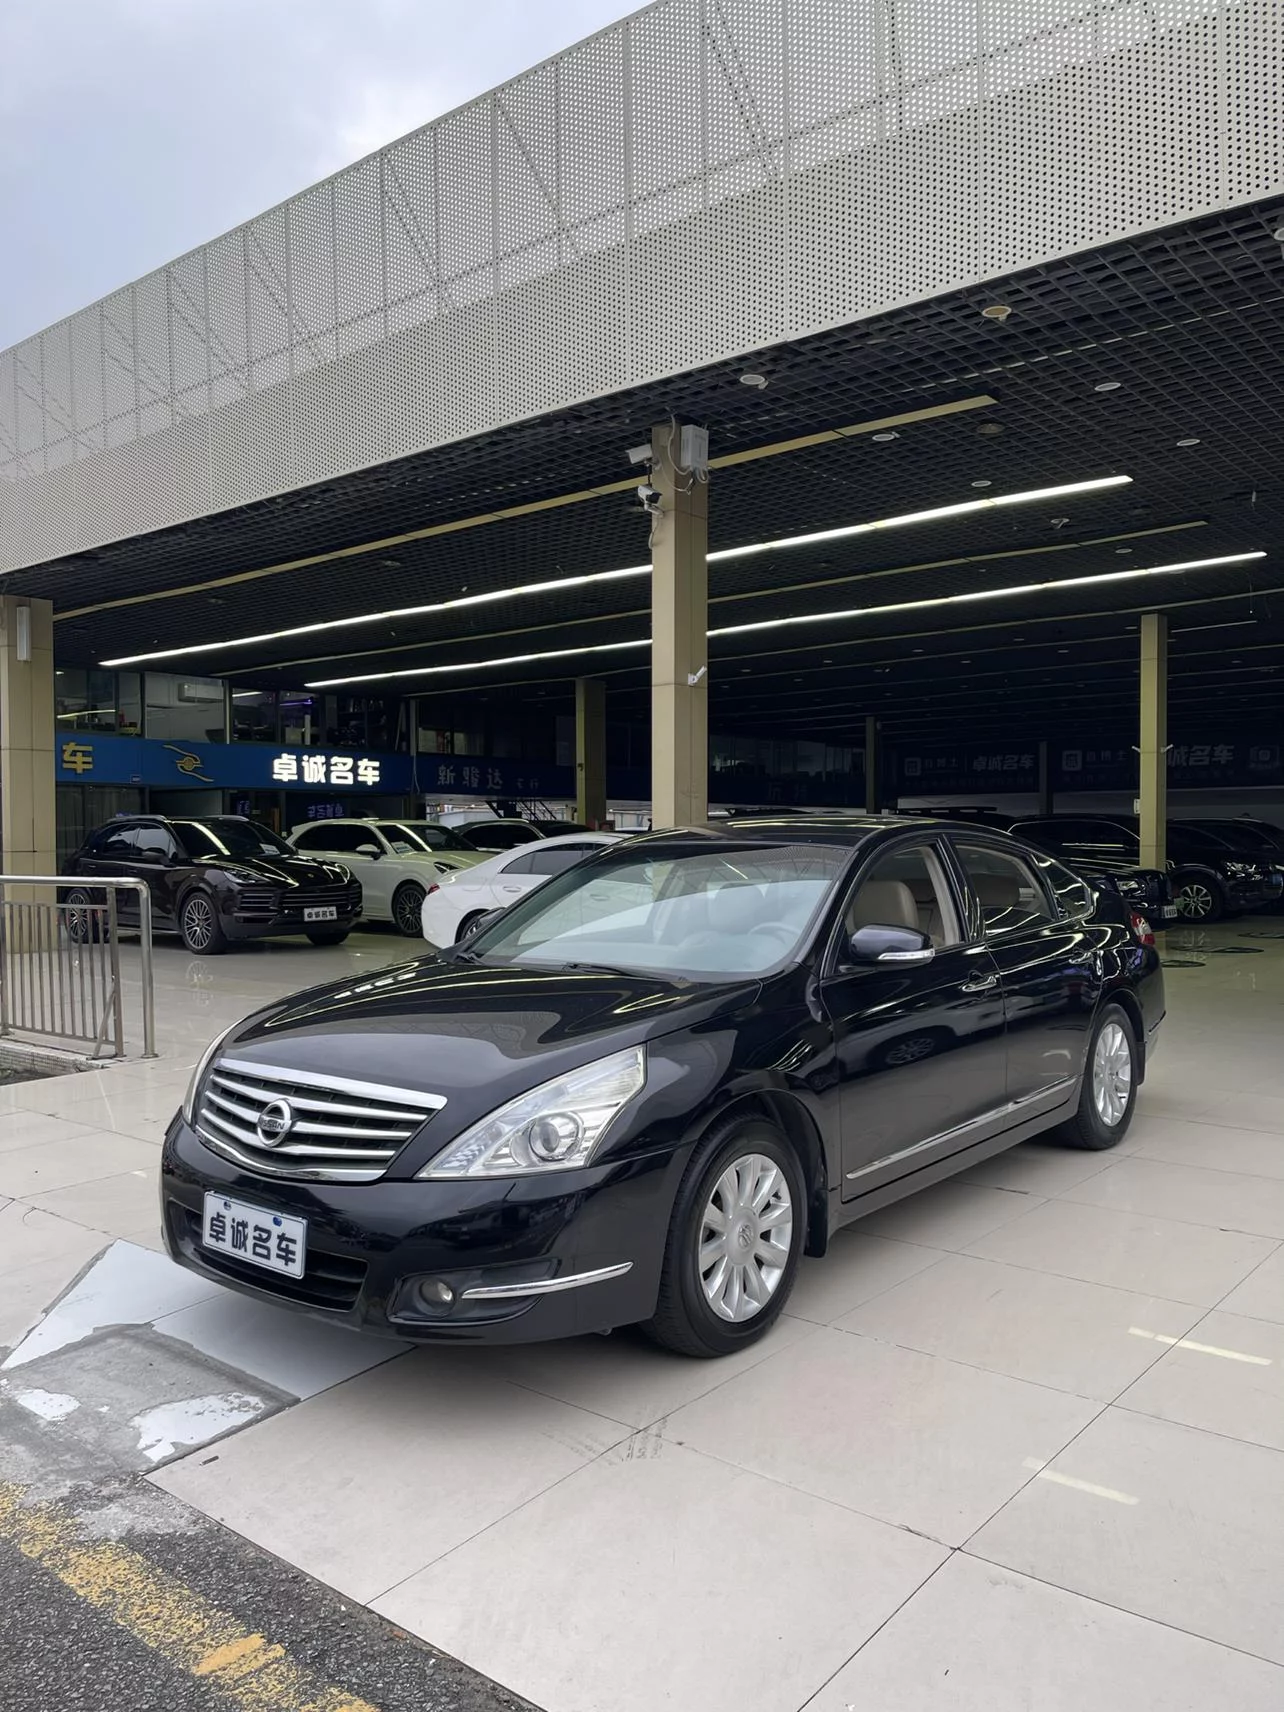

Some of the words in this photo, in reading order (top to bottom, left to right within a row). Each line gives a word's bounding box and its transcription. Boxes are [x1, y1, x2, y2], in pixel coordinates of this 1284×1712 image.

[62, 742, 93, 774] 车
[273, 753, 380, 785] 卓诚名车
[973, 754, 1035, 771] 卓诚名车
[209, 1212, 297, 1266] 卓诚名车
